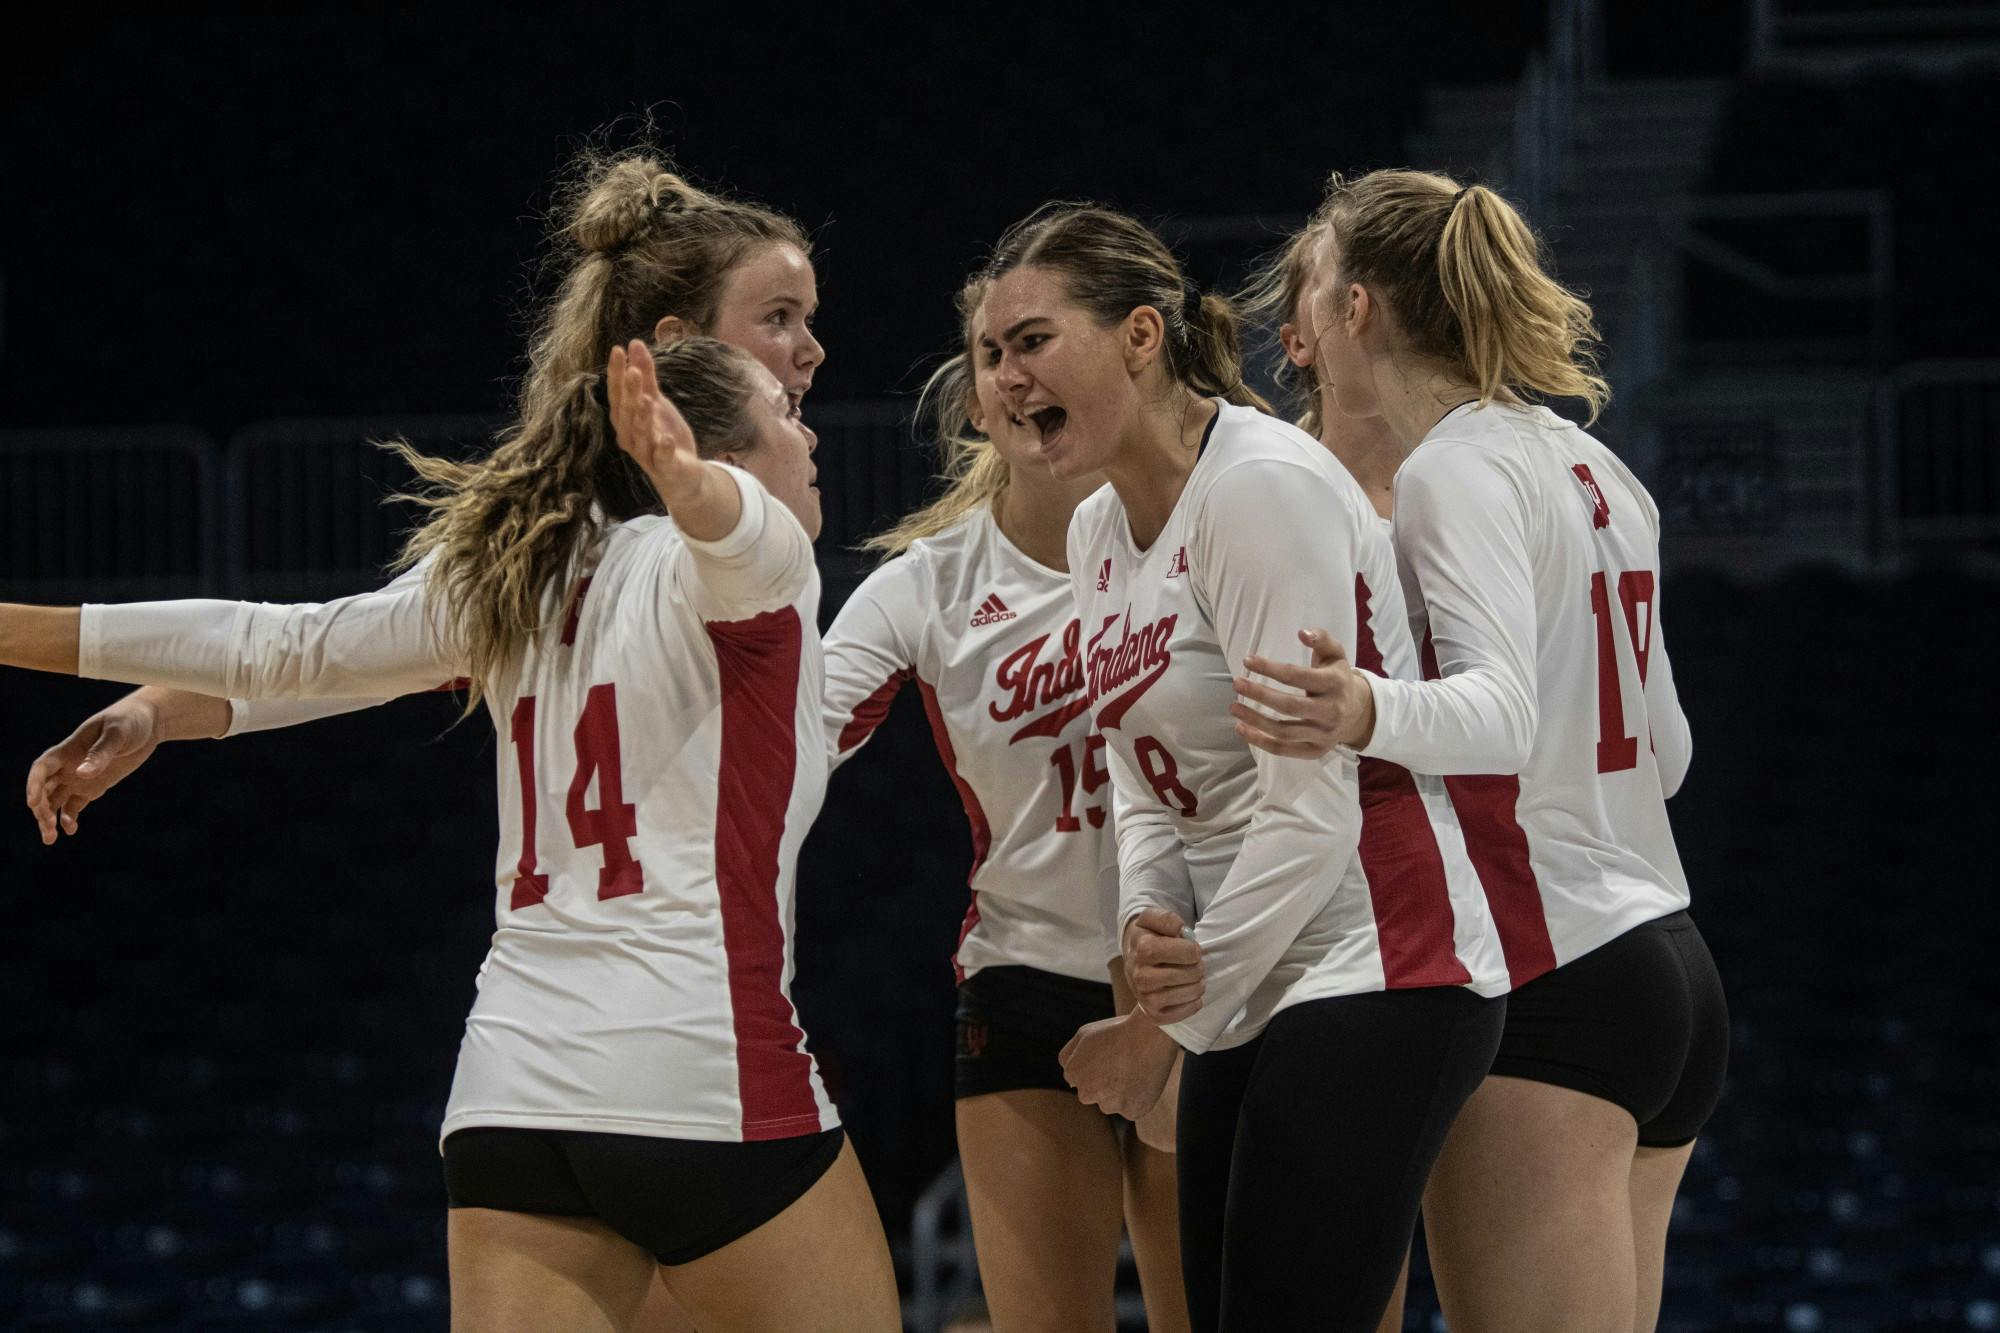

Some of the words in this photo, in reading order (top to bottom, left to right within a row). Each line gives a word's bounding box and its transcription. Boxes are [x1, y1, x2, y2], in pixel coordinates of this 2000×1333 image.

[970, 611, 1017, 628] adidas
[511, 682, 643, 911] 14
[1051, 734, 1110, 832] 15
